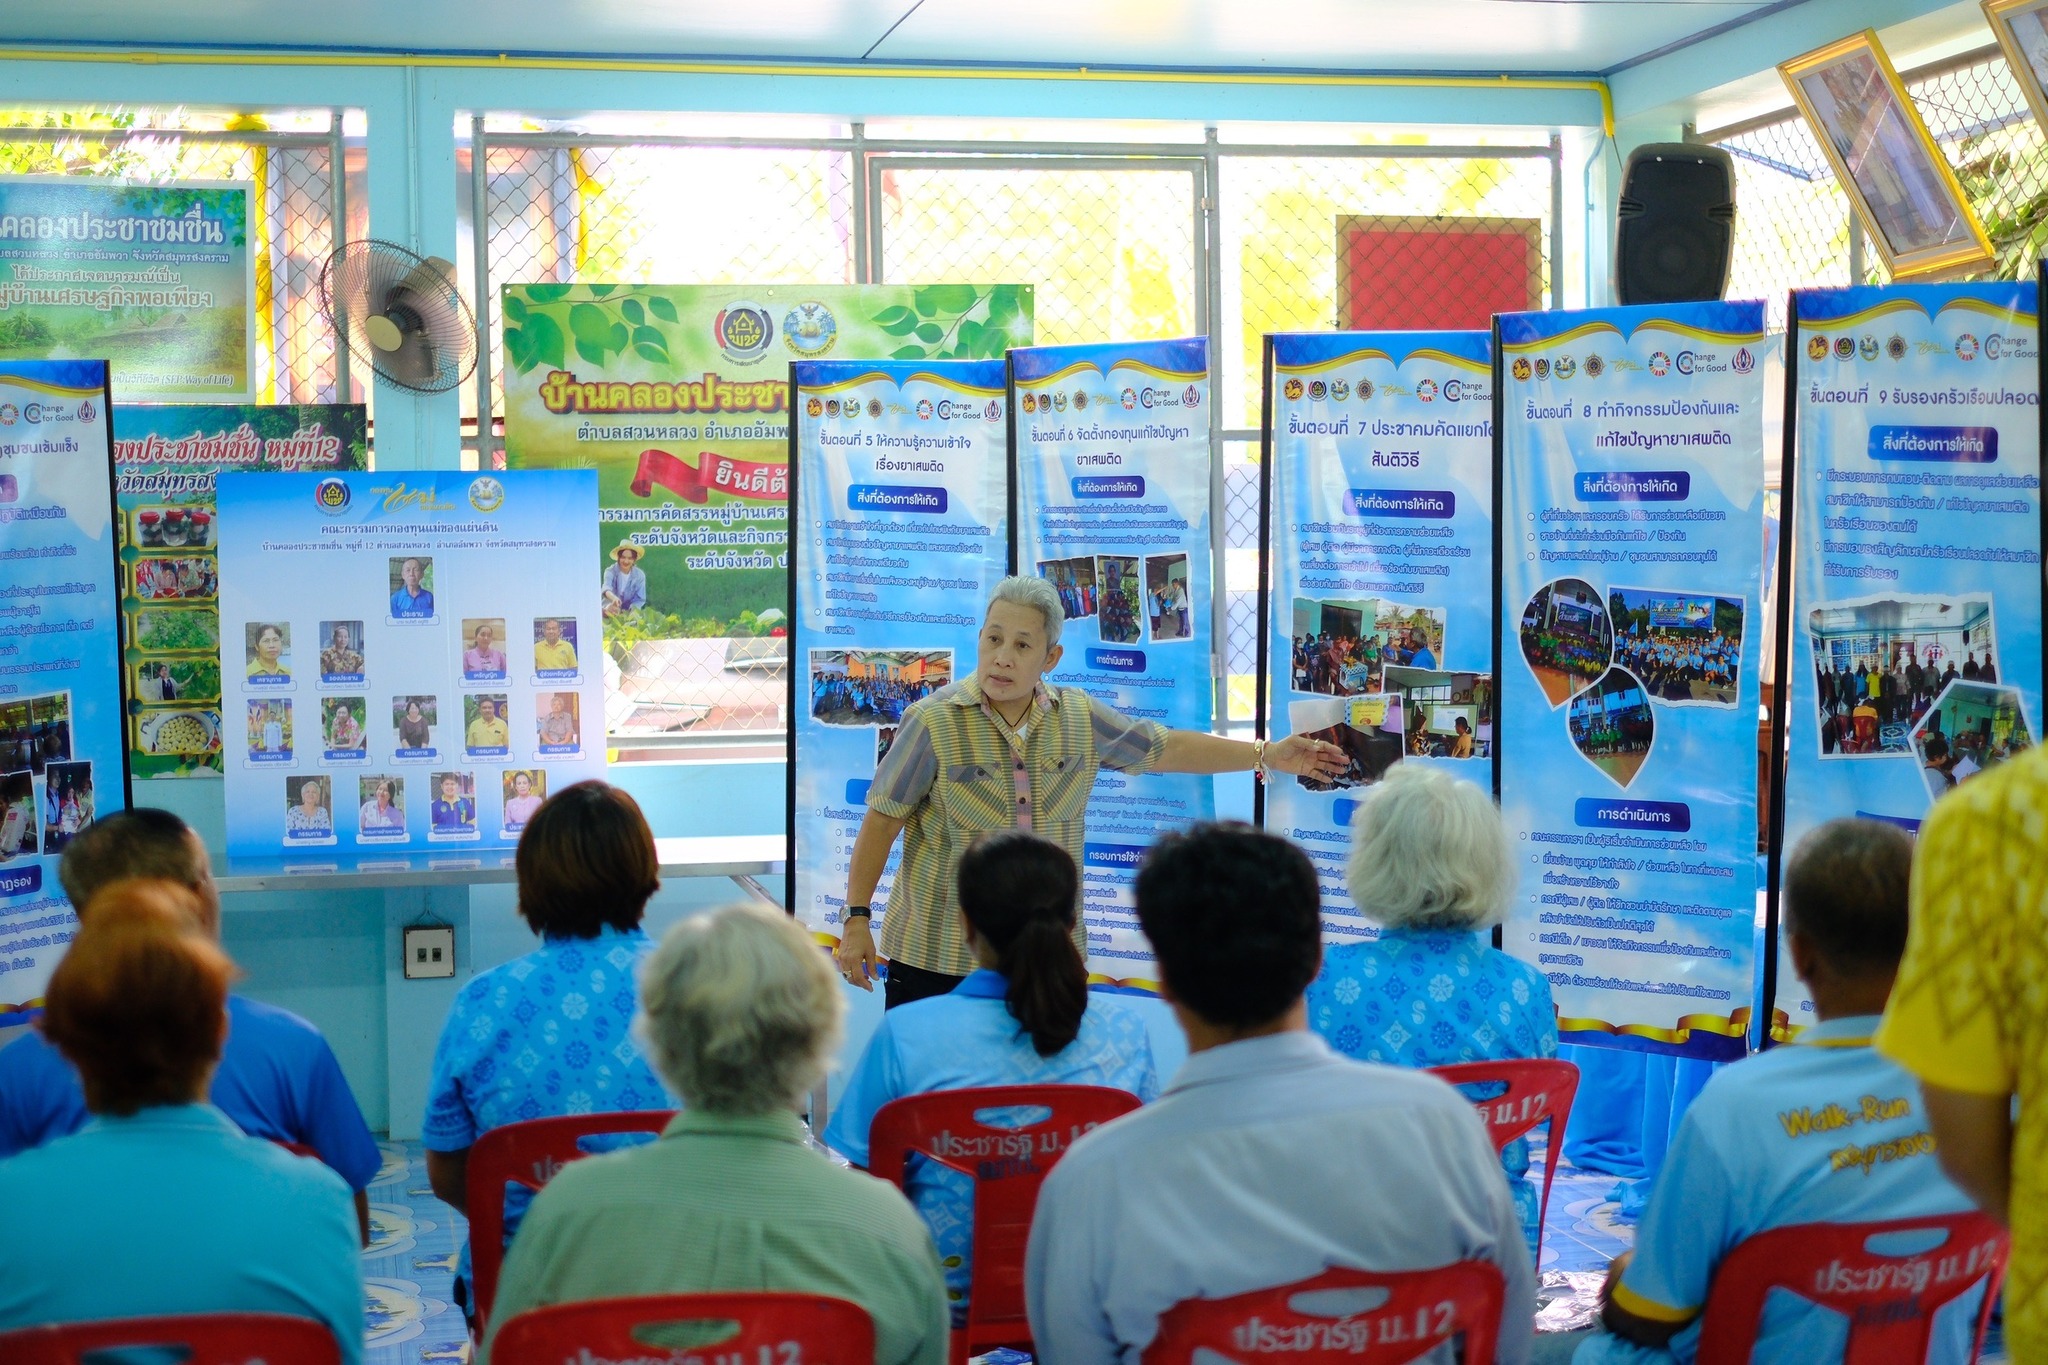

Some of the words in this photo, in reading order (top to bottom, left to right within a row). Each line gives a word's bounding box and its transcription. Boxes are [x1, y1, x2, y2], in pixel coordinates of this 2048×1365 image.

[0, 203, 224, 243] คลองประชาชมชื่น
[2001, 349, 2012, 358] for
[1694, 364, 1704, 372] for
[1706, 363, 1727, 373] Good
[1810, 382, 1869, 404] ขั้นตอนที่
[1879, 390, 1888, 404] 9
[1163, 398, 1178, 406] Good
[1526, 398, 1572, 419] ขั้นตอนที่
[1583, 404, 1592, 418] 8
[1597, 399, 1740, 418] ทำกิจกรรมป้องกันและ
[43, 414, 53, 422] for
[56, 413, 74, 422] Good
[962, 412, 981, 420] Good
[1289, 413, 1348, 434] ขั้นตอนที่
[1358, 421, 1366, 435] 7
[577, 421, 698, 441] ตำบลสวนหลวง
[1032, 425, 1065, 442] ขั้นตอนที่
[1068, 430, 1074, 441] 6
[1076, 423, 1189, 443] จัดตั้งกองทุนแก้ไขปัญหา
[1596, 429, 1732, 450] แก้ไขปัญหายาเสพติด
[820, 429, 861, 446] ขั้นตอนที่
[865, 436, 873, 446] 5
[876, 434, 971, 451] ให้ความรู้ความเข้าใจ
[1883, 431, 1984, 453] สิ่งที่ต้องการให้เกิด
[876, 455, 944, 472] เรื่องยาเสพติด
[1077, 452, 1122, 466] ยาเสพติด
[1372, 450, 1420, 467] สันติวิธี
[1077, 479, 1137, 493] สิ่งที่ต้องการให้เกิด
[1583, 477, 1678, 493] สิ่งที่ต้องการให้เกิด
[858, 489, 938, 506] สิ่งที่ต้องการให้เกิด
[1355, 495, 1443, 511] สิ่งที่ต้องการให้เกิด
[320, 520, 499, 537] คณะกรรมการกองทุนแม่ของแผ่นดิน
[365, 542, 374, 550] 12
[686, 551, 773, 570] ระดับจังหวัด
[1096, 655, 1133, 666] การดำเนินการ
[1598, 806, 1671, 823] การดำเนินการ
[1089, 850, 1147, 863] กรอบการใช้จ่า
